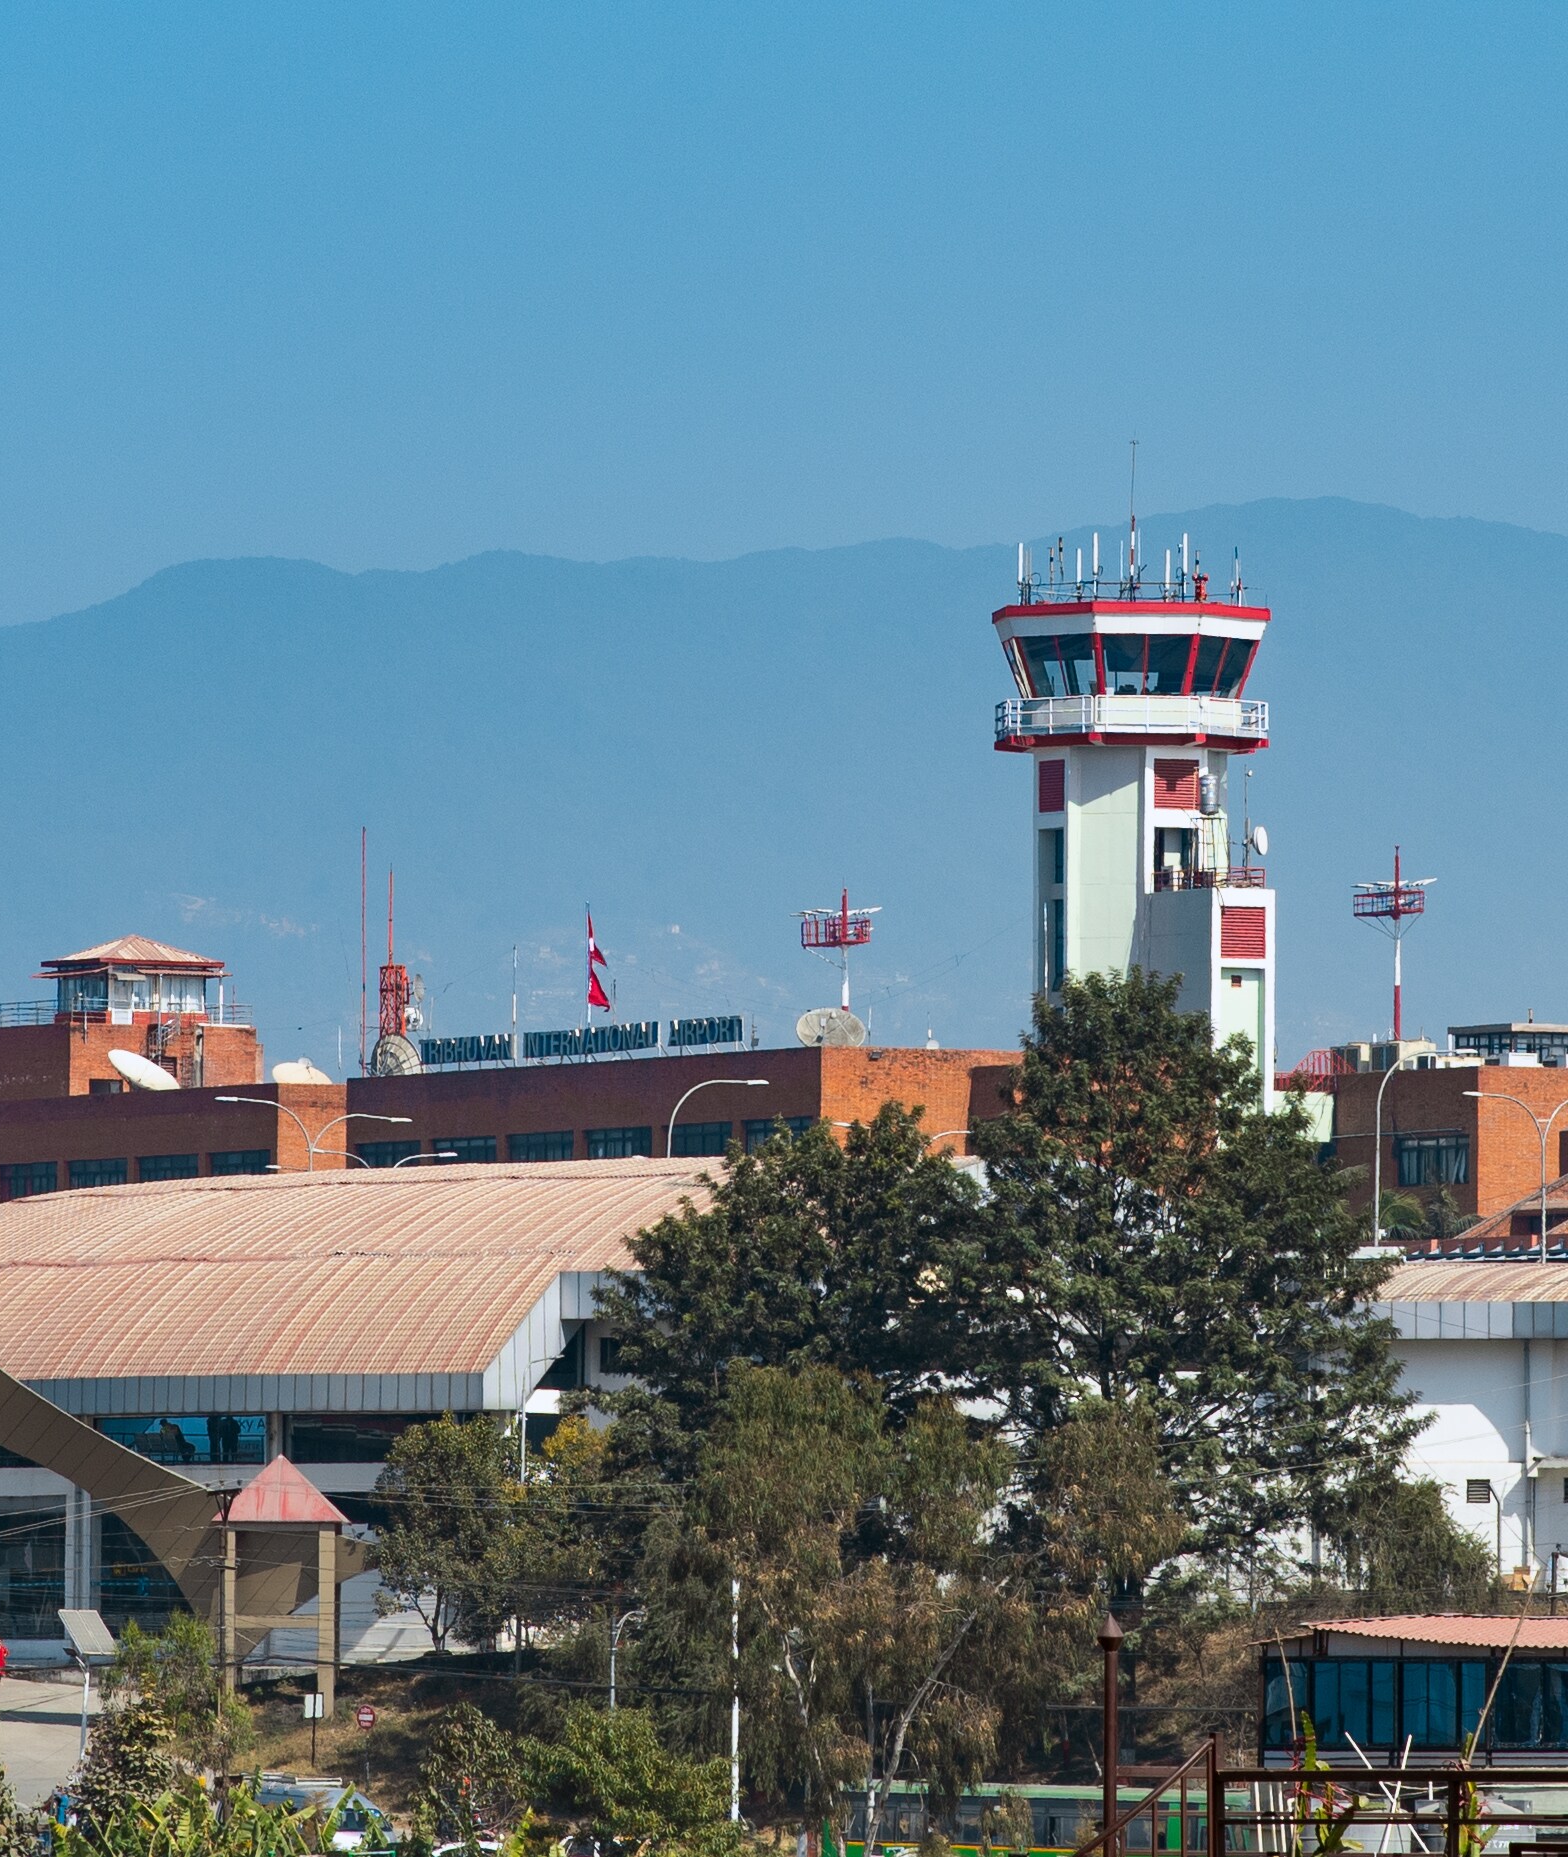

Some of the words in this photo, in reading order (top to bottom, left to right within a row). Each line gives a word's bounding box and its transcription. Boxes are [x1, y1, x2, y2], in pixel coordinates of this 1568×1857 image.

[419, 1034, 512, 1064] TRIBHUVAN
[523, 1022, 660, 1058] INTERNATIONAL
[668, 1016, 743, 1046] AIRPORT
[239, 1418, 254, 1432] ky
